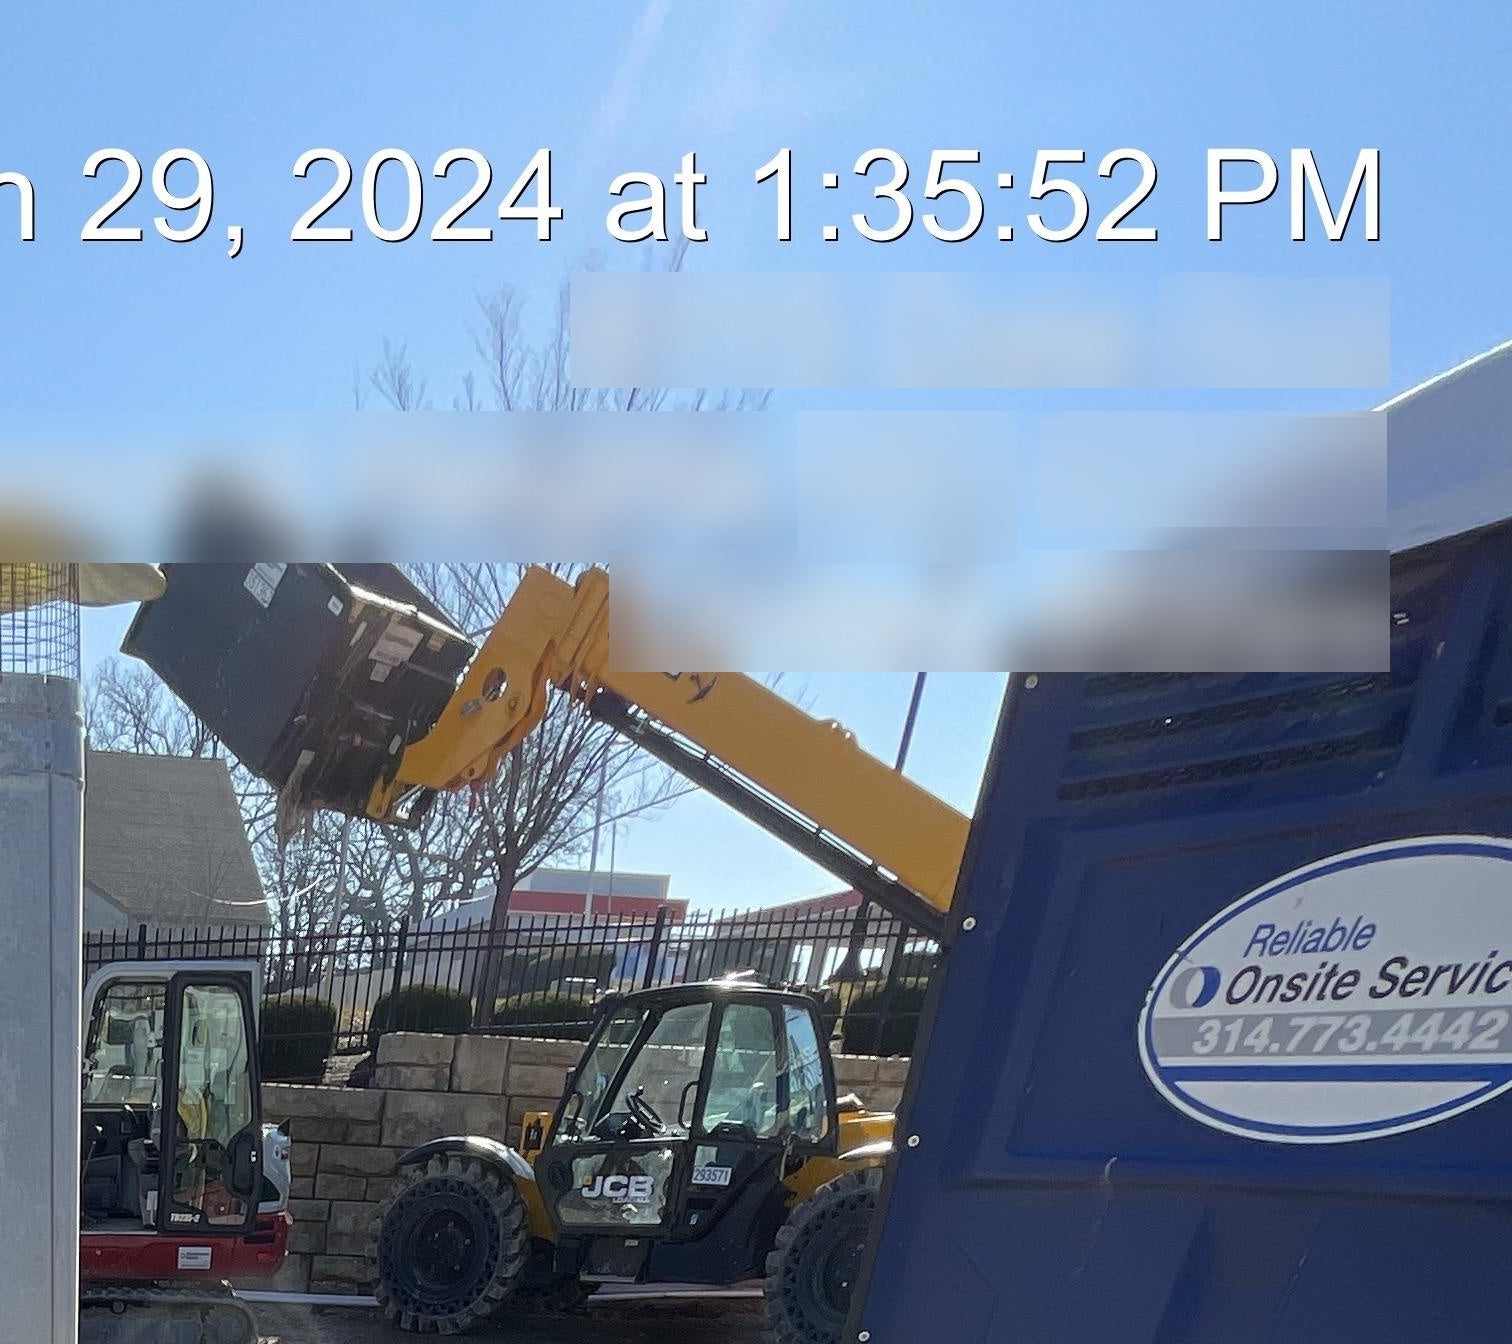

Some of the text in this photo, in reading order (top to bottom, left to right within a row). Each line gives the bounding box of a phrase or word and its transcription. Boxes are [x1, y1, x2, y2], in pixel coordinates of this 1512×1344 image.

[1243, 916, 1377, 958] Reliable
[1226, 950, 1512, 1005] Onsite Servic
[1192, 1009, 1509, 1055] 314.773.4442
[582, 1175, 654, 1198] JCB
[694, 1168, 729, 1183] 293571
